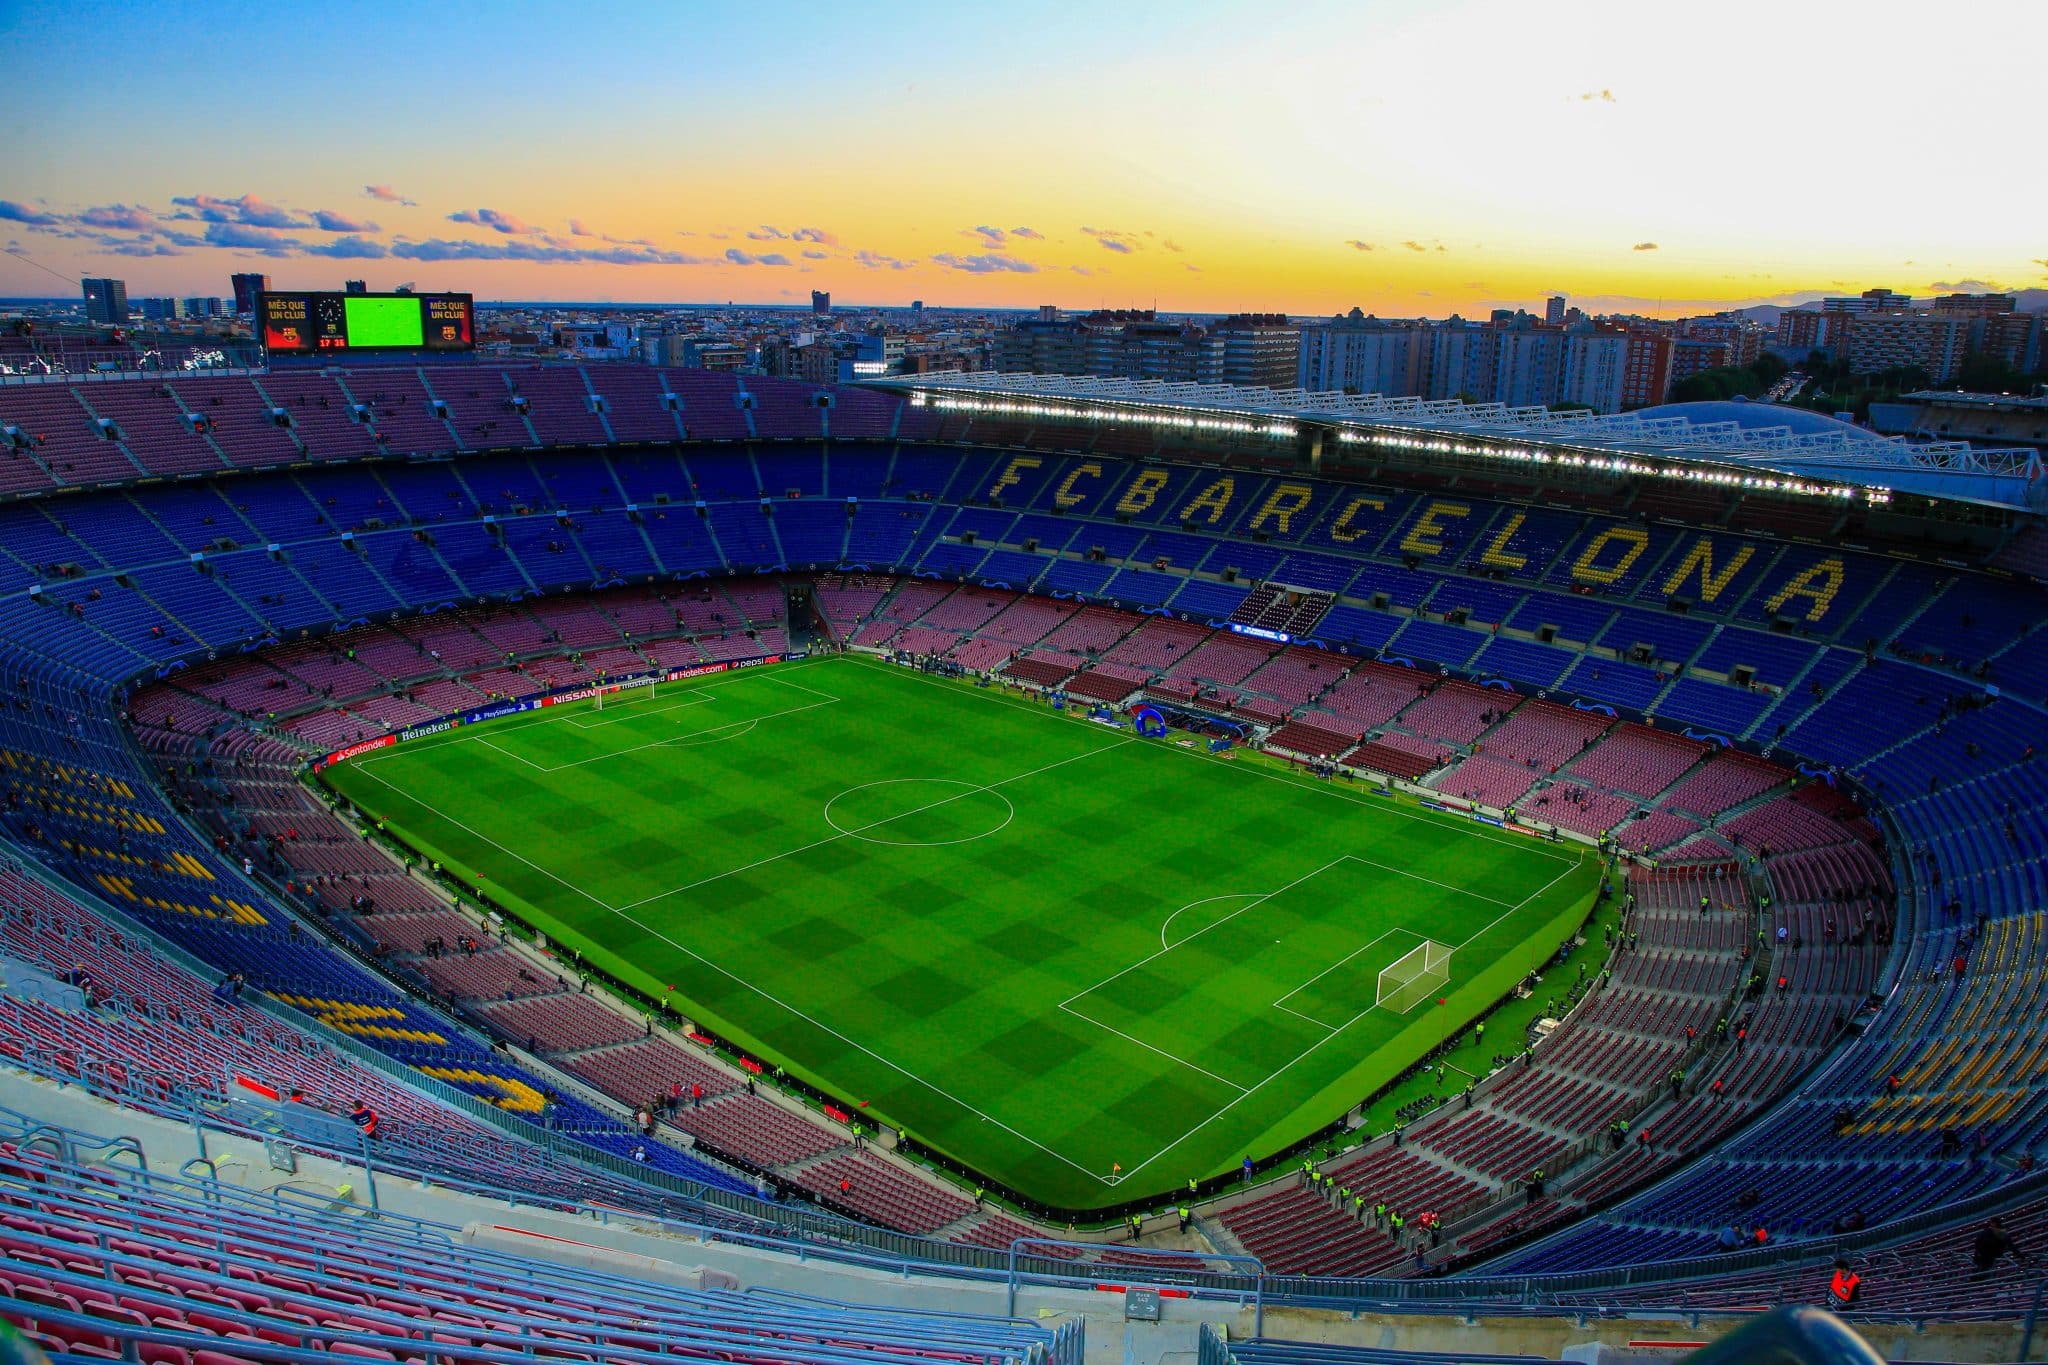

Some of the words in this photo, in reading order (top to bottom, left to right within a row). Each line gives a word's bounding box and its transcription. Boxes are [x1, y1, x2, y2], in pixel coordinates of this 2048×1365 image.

[288, 301, 306, 311] QUE
[448, 302, 465, 311] QUE
[270, 311, 283, 319] UN
[284, 311, 306, 320] CLUB
[431, 311, 443, 319] UN
[444, 311, 465, 319] CLUB
[740, 657, 764, 668] pepsi
[679, 664, 723, 679] Hotels.com
[552, 688, 597, 705] NISSAN
[483, 706, 517, 719] PlayStation
[401, 721, 451, 742] Heineken
[344, 738, 387, 759] Santander
